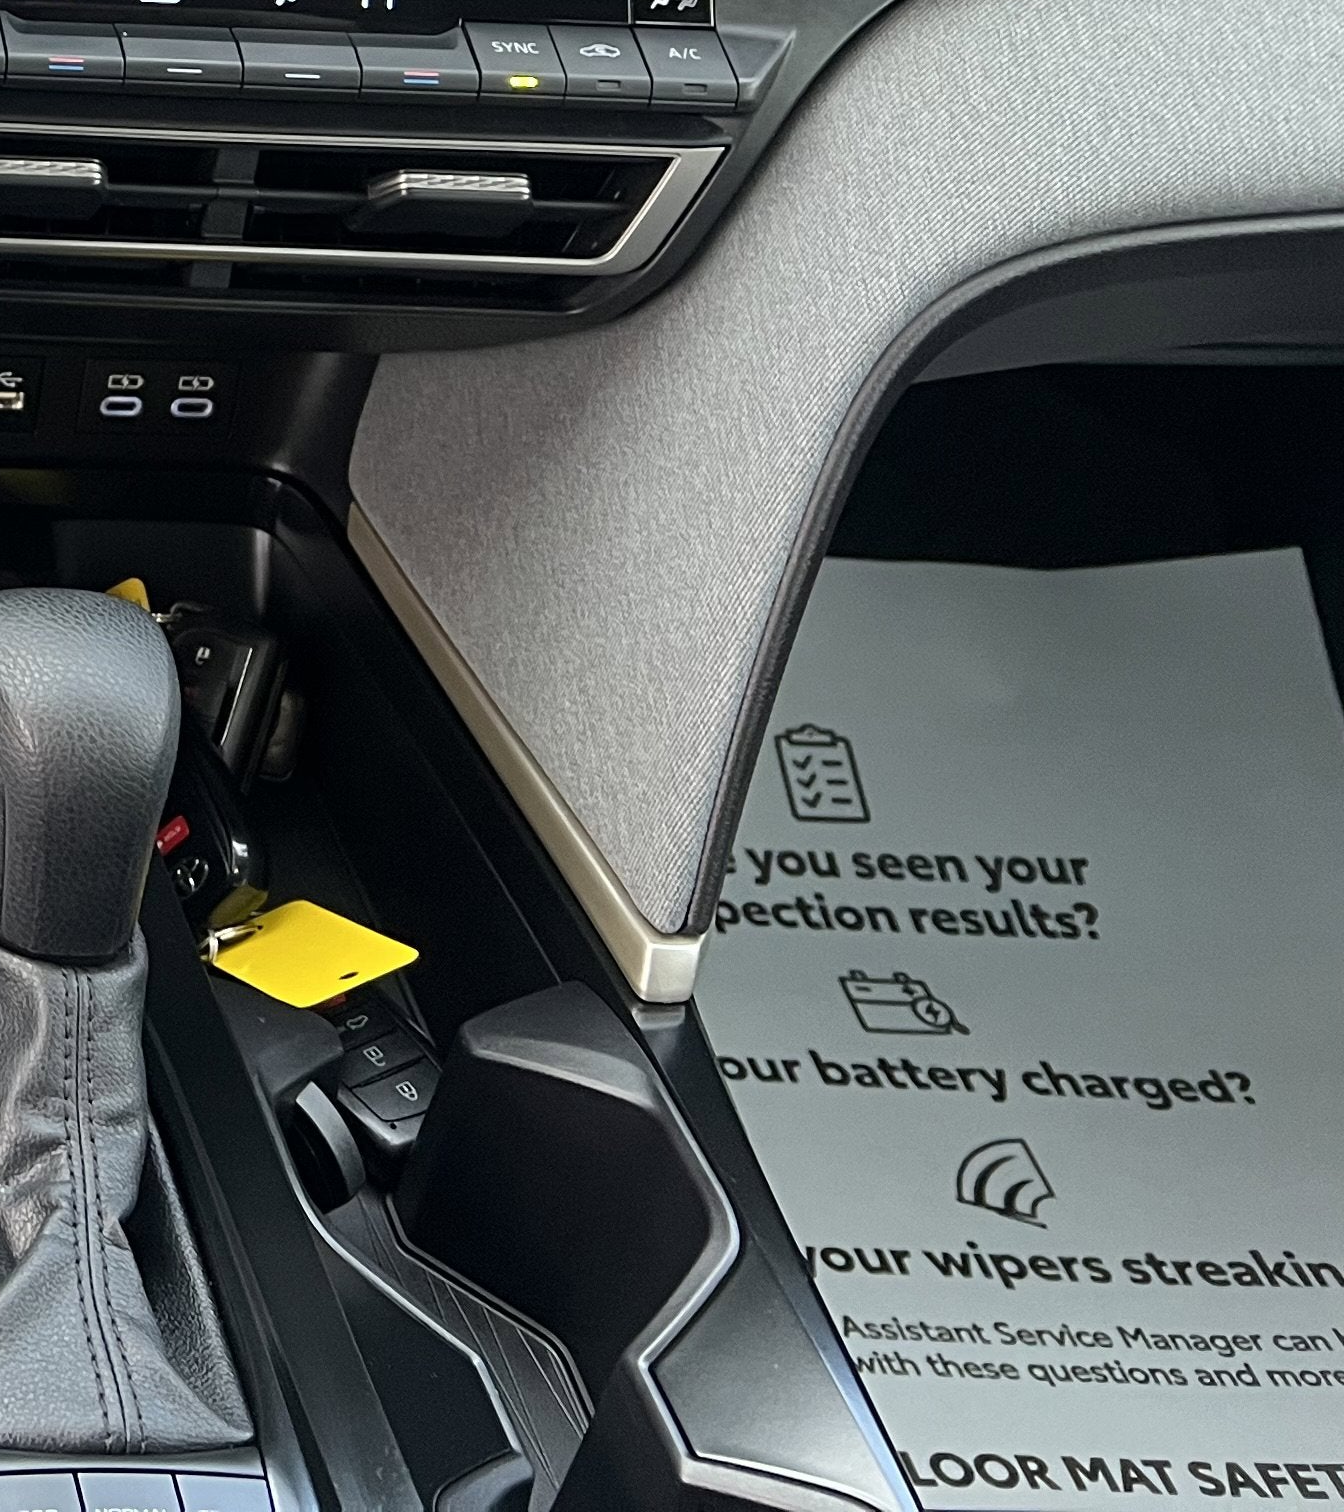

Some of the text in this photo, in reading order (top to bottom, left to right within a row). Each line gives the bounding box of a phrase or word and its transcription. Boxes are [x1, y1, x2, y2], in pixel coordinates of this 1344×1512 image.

[492, 41, 540, 56] SYNC
[669, 46, 702, 60] A/C
[744, 847, 841, 885] you
[852, 851, 969, 883] seen
[975, 853, 1089, 893] your
[908, 898, 1101, 940] results?
[808, 1049, 1008, 1103] battery
[1021, 1060, 1257, 1111] charged?
[923, 1241, 1112, 1289] wipers
[1122, 1250, 1344, 1288] streakin
[842, 1314, 990, 1345] Assistant
[993, 1321, 1113, 1349] Service
[1116, 1326, 1262, 1357] Manager
[1272, 1334, 1333, 1352] can
[926, 1354, 1018, 1381] these
[1027, 1359, 1188, 1387] questions
[1197, 1363, 1262, 1387] and
[1061, 1455, 1179, 1496] MAT
